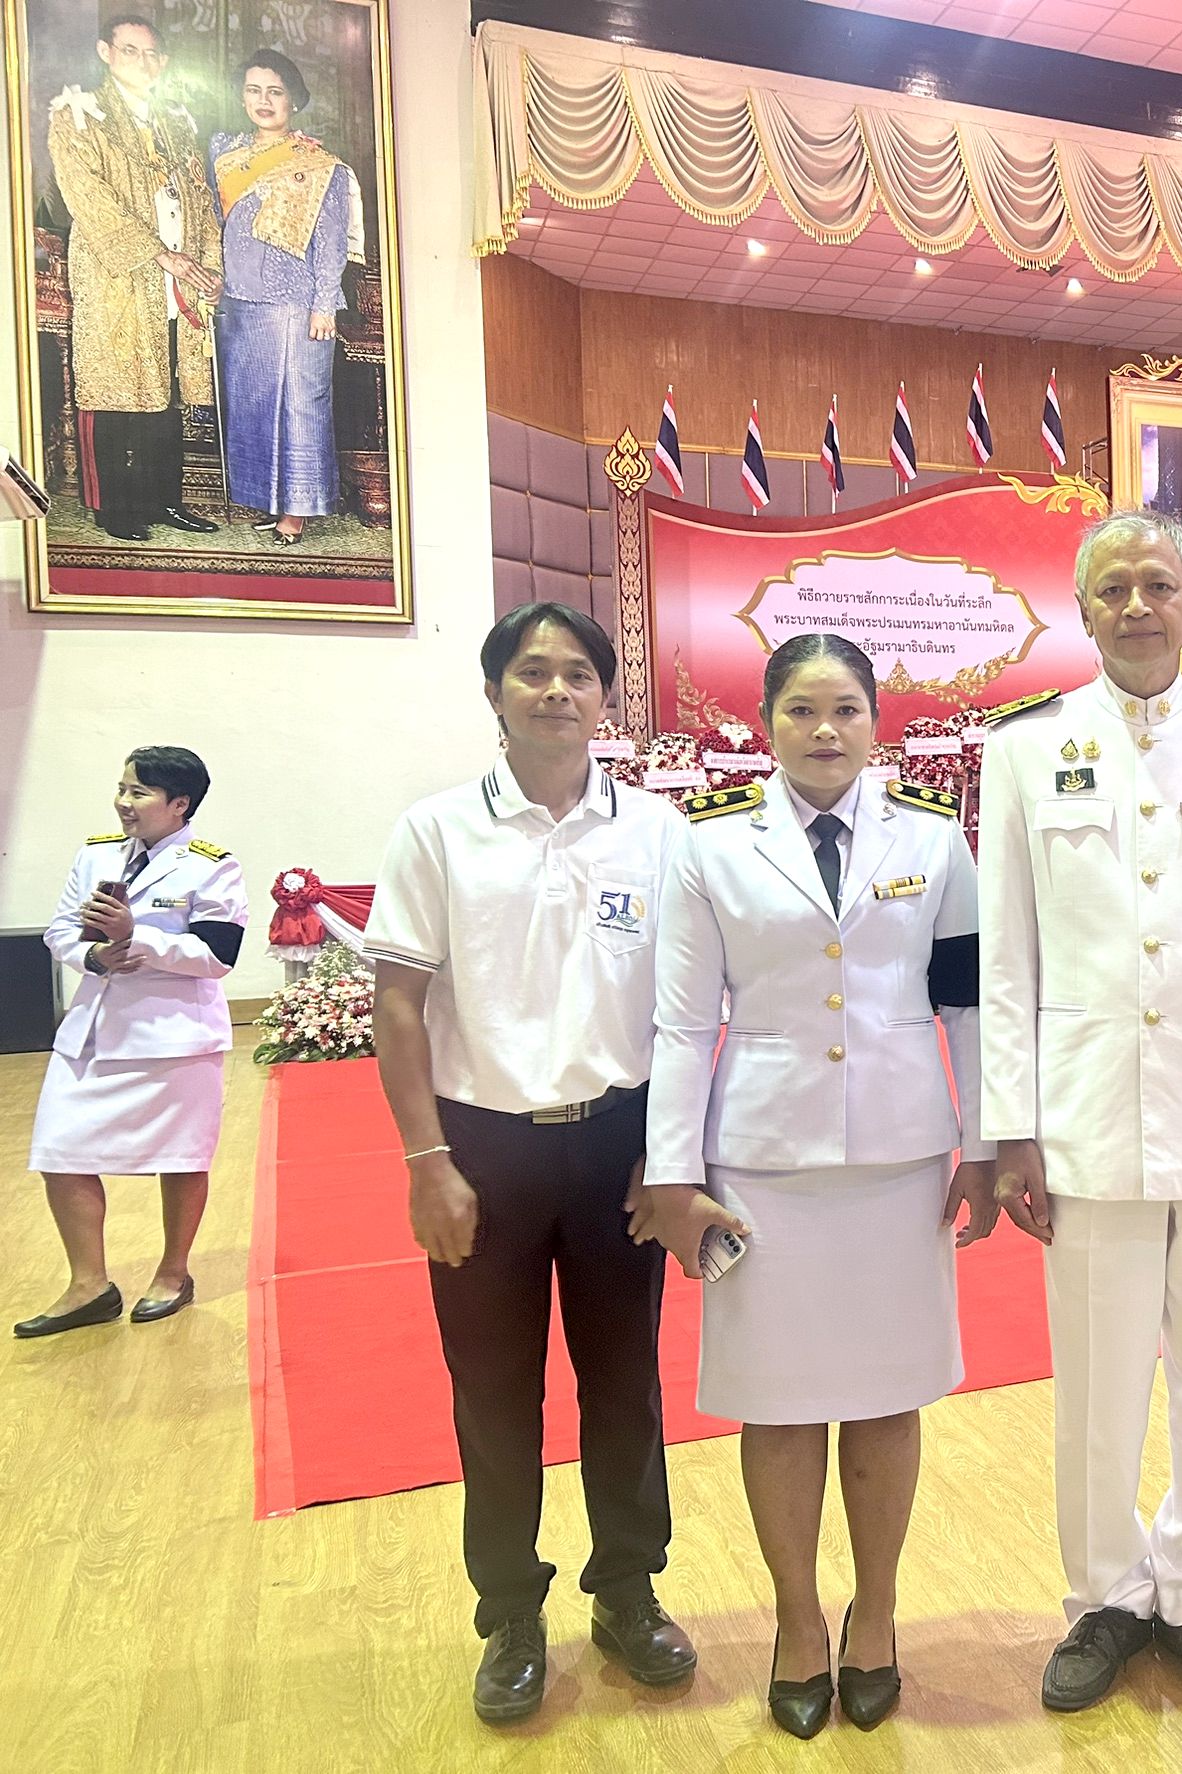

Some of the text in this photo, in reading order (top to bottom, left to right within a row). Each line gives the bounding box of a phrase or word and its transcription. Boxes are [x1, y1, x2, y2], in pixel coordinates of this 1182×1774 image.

[854, 638, 956, 656] ะอัฐมรามาธิบดินทร
[597, 891, 631, 920] 51
